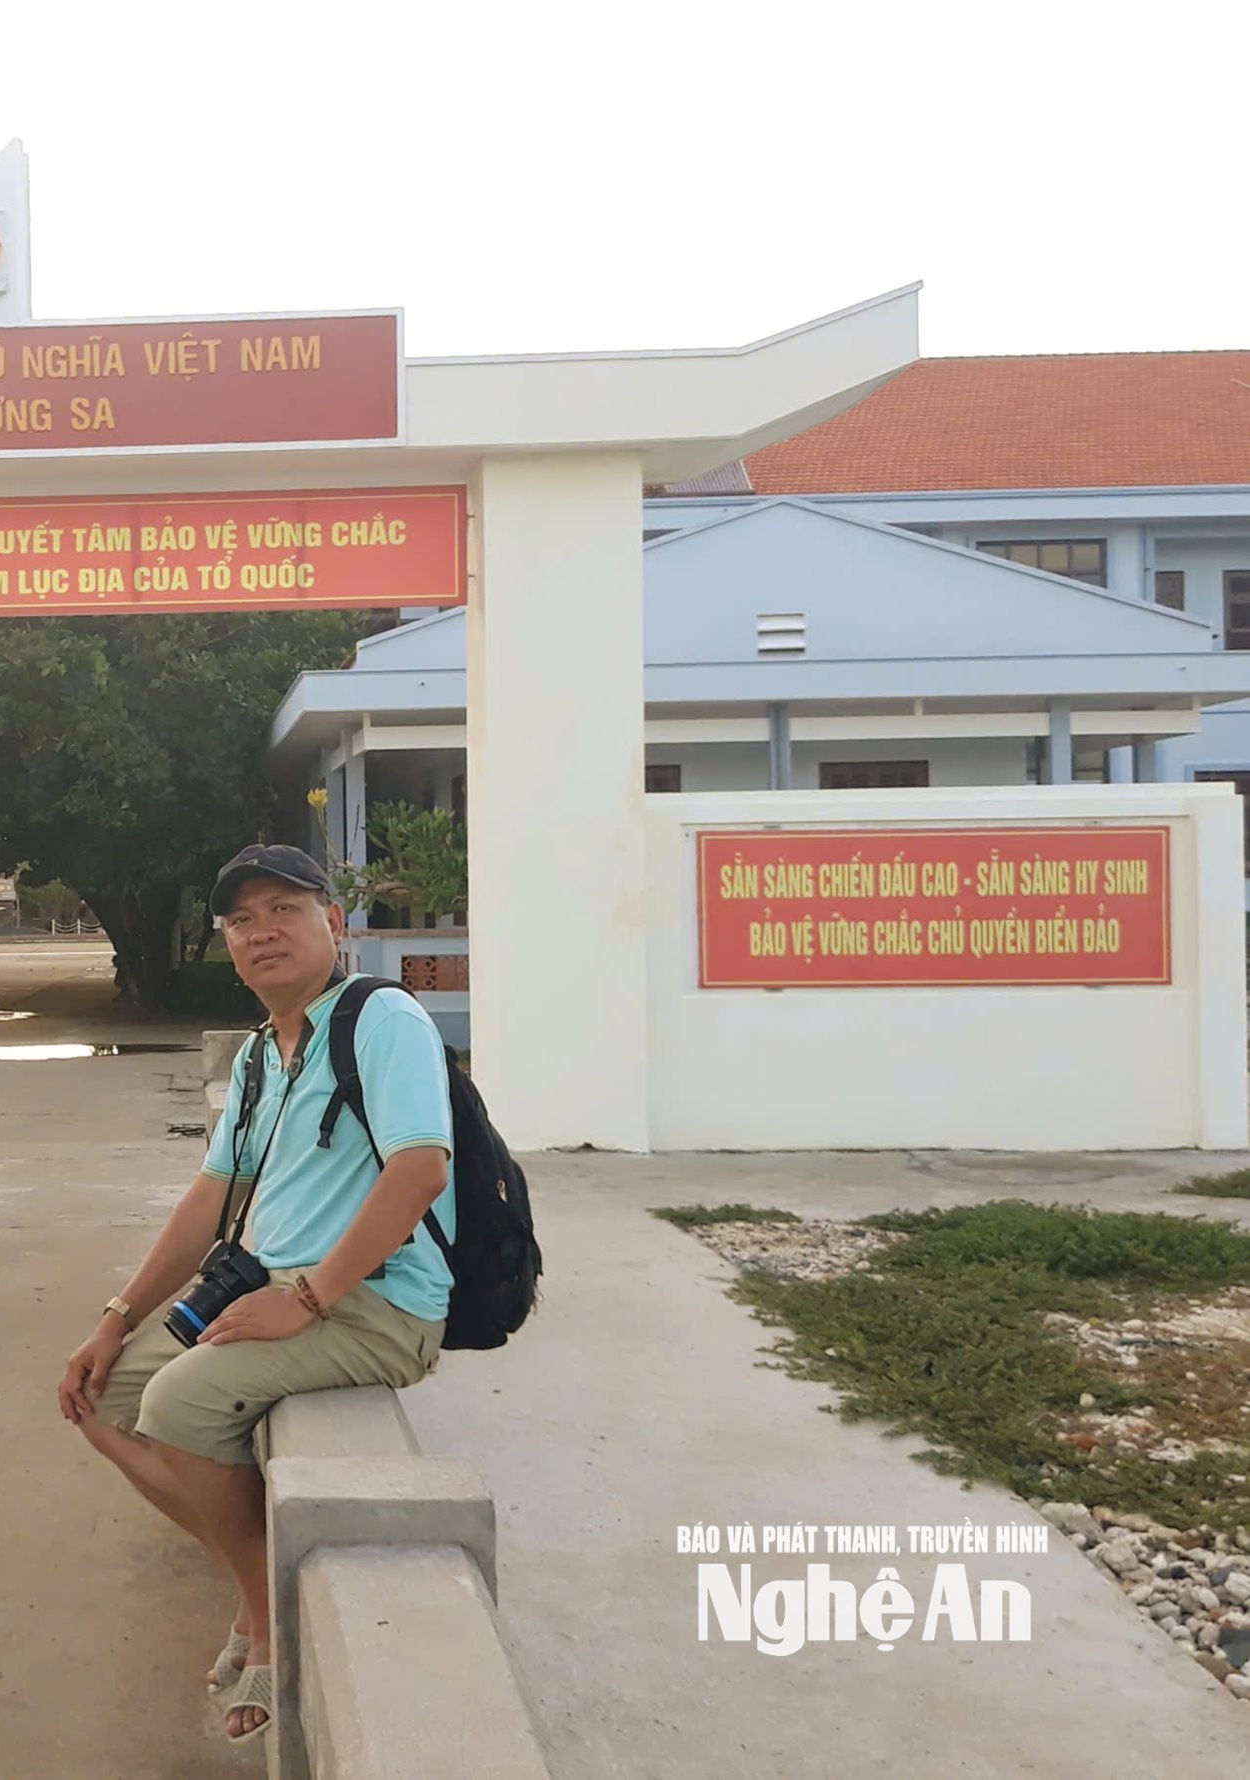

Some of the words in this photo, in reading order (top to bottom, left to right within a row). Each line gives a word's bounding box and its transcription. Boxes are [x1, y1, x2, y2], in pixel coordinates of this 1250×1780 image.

[22, 336, 126, 379] NGHĨA
[144, 332, 222, 381] VIỆT
[240, 335, 321, 372] NAM
[69, 397, 116, 430] SA
[72, 523, 131, 552] TÂM
[140, 516, 196, 551] BẢO
[204, 519, 238, 555] VỆ
[247, 517, 322, 549] VỮNG
[331, 512, 407, 546] CHẮC
[18, 568, 69, 599] LỤC
[78, 567, 125, 598] ĐỊA
[133, 556, 189, 591] CỦA
[197, 556, 232, 590] TỔ
[240, 554, 315, 592] QUỐC
[720, 852, 758, 899] SẴN
[763, 857, 814, 898] SÀNG
[819, 851, 874, 898] CHIẾN
[879, 850, 916, 897] ĐẤU
[921, 862, 958, 896] CAO
[976, 849, 1014, 896] SẴN
[1020, 853, 1070, 895] SÀNG
[1075, 860, 1098, 894] HY
[1103, 860, 1148, 894] SINH
[750, 907, 786, 956] BẢO
[791, 914, 814, 964] VỆ
[818, 912, 868, 955] VỮNG
[873, 908, 922, 955] CHẮC
[927, 905, 964, 954] CHỦ
[970, 906, 1030, 958] QUYỀN
[1035, 904, 1078, 953] BIỂN
[1083, 903, 1120, 953] ĐẢO
